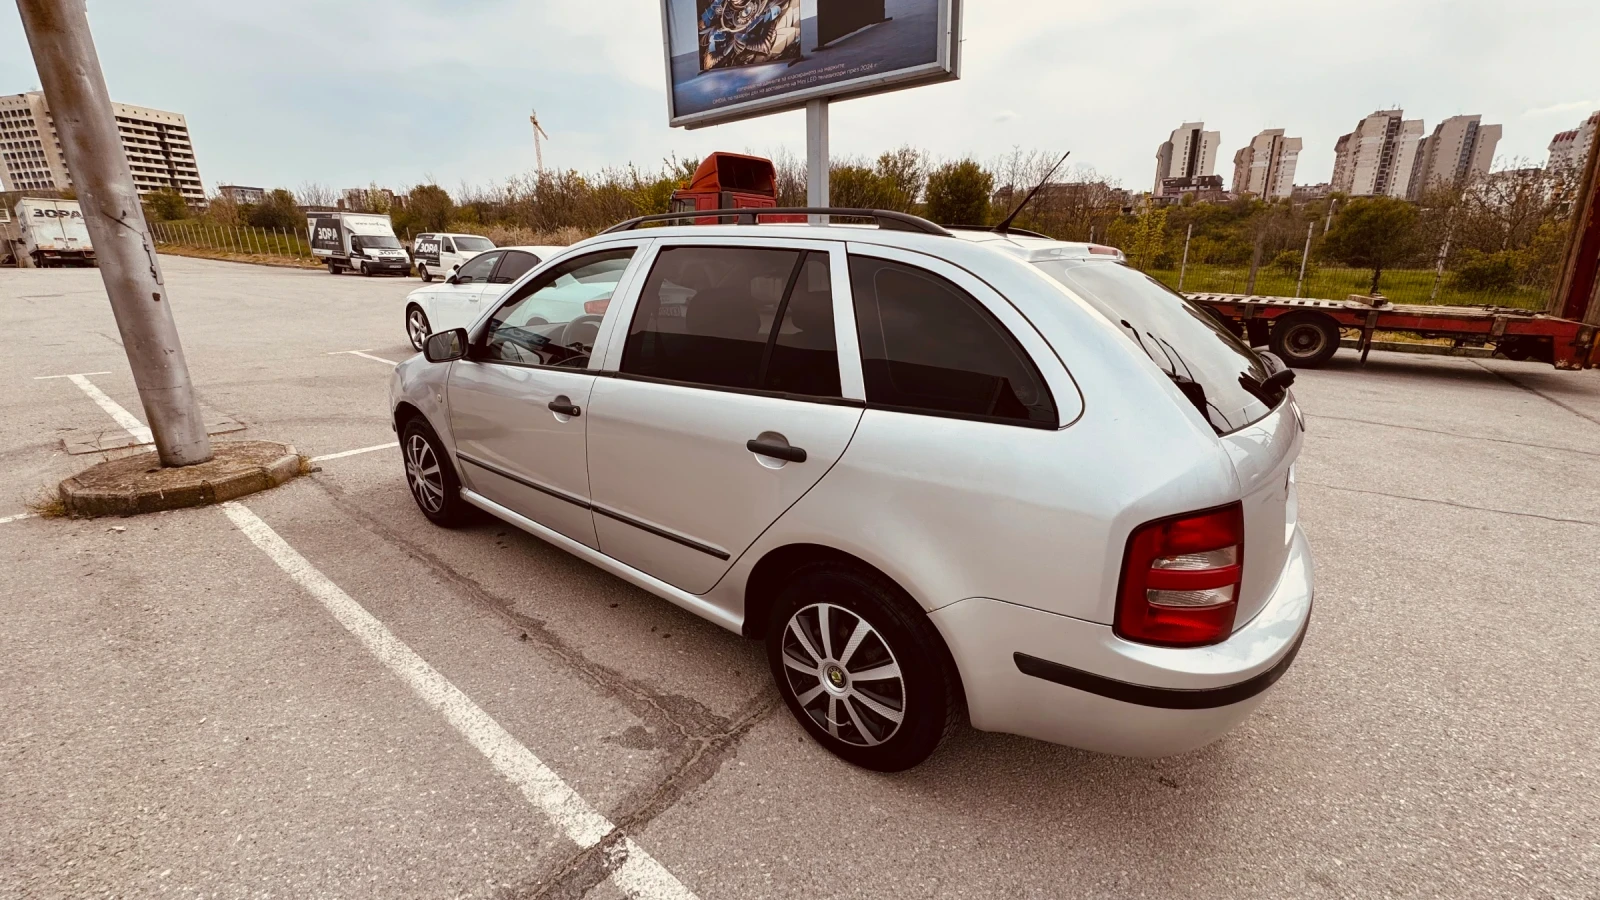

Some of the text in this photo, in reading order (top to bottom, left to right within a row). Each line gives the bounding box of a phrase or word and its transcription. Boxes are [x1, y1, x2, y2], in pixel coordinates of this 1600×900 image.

[807, 75, 817, 83] LED
[860, 62, 873, 71] 2024
[824, 63, 845, 72] марките
[317, 227, 338, 241] ЗОРА
[420, 242, 438, 254] ЗОРА
